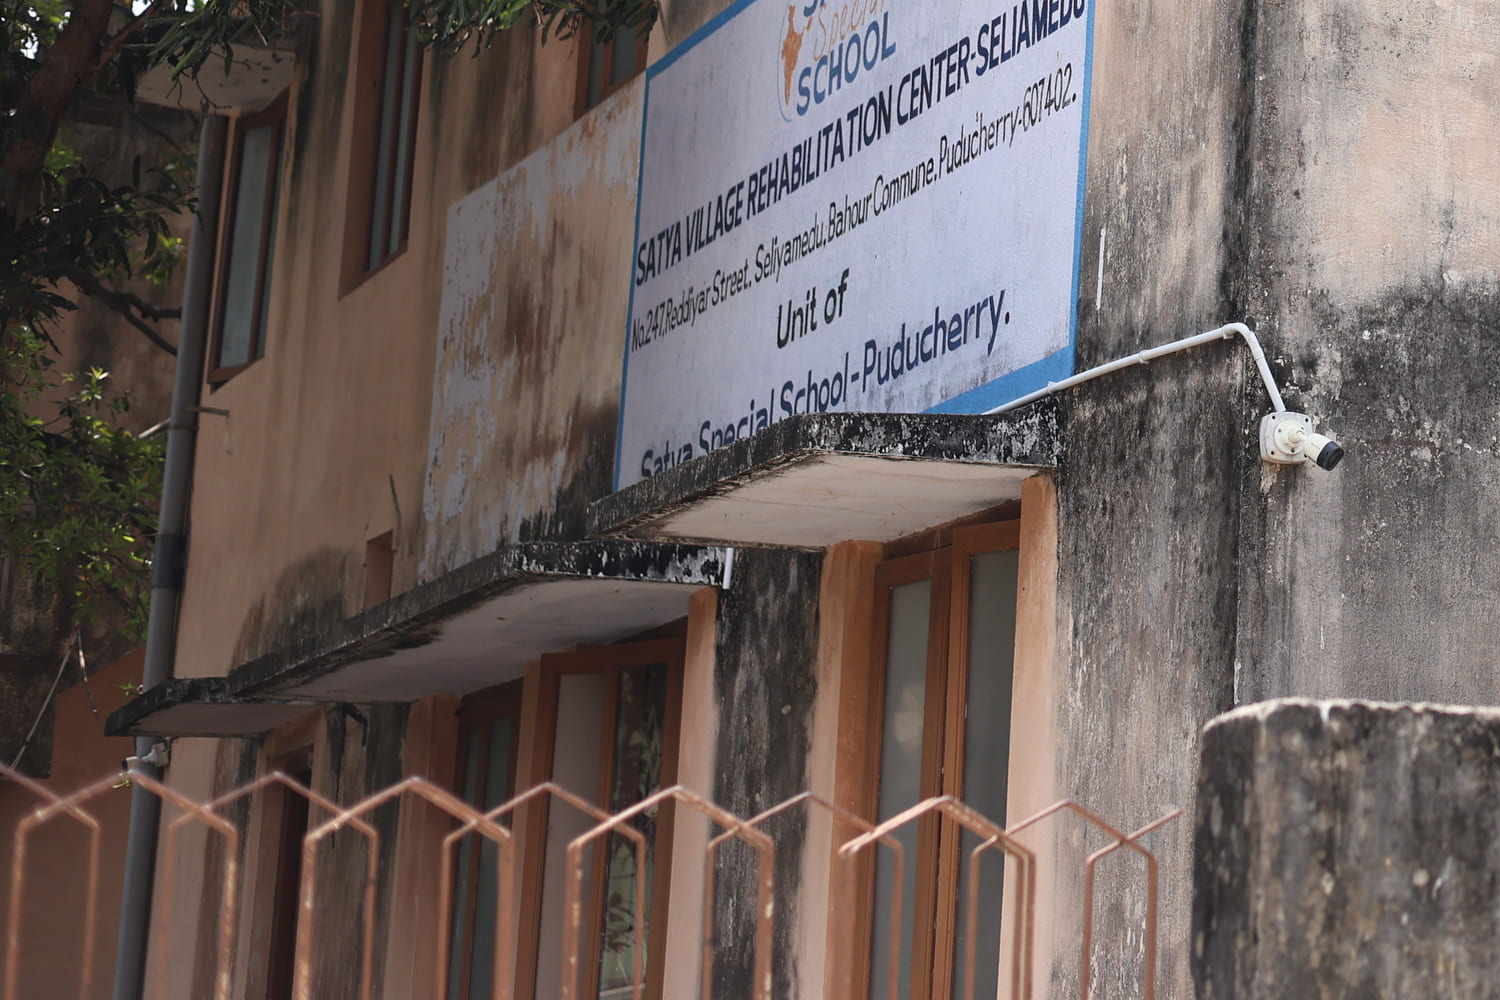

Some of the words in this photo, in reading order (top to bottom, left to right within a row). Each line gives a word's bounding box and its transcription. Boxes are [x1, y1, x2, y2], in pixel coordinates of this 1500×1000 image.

[796, 11, 896, 117] SCHOOL
[636, 221, 681, 287] SATYA
[686, 181, 745, 257] VILLAGE
[746, 84, 893, 221] REHABILITATION
[775, 286, 818, 350] Unit
[824, 267, 850, 325] of
